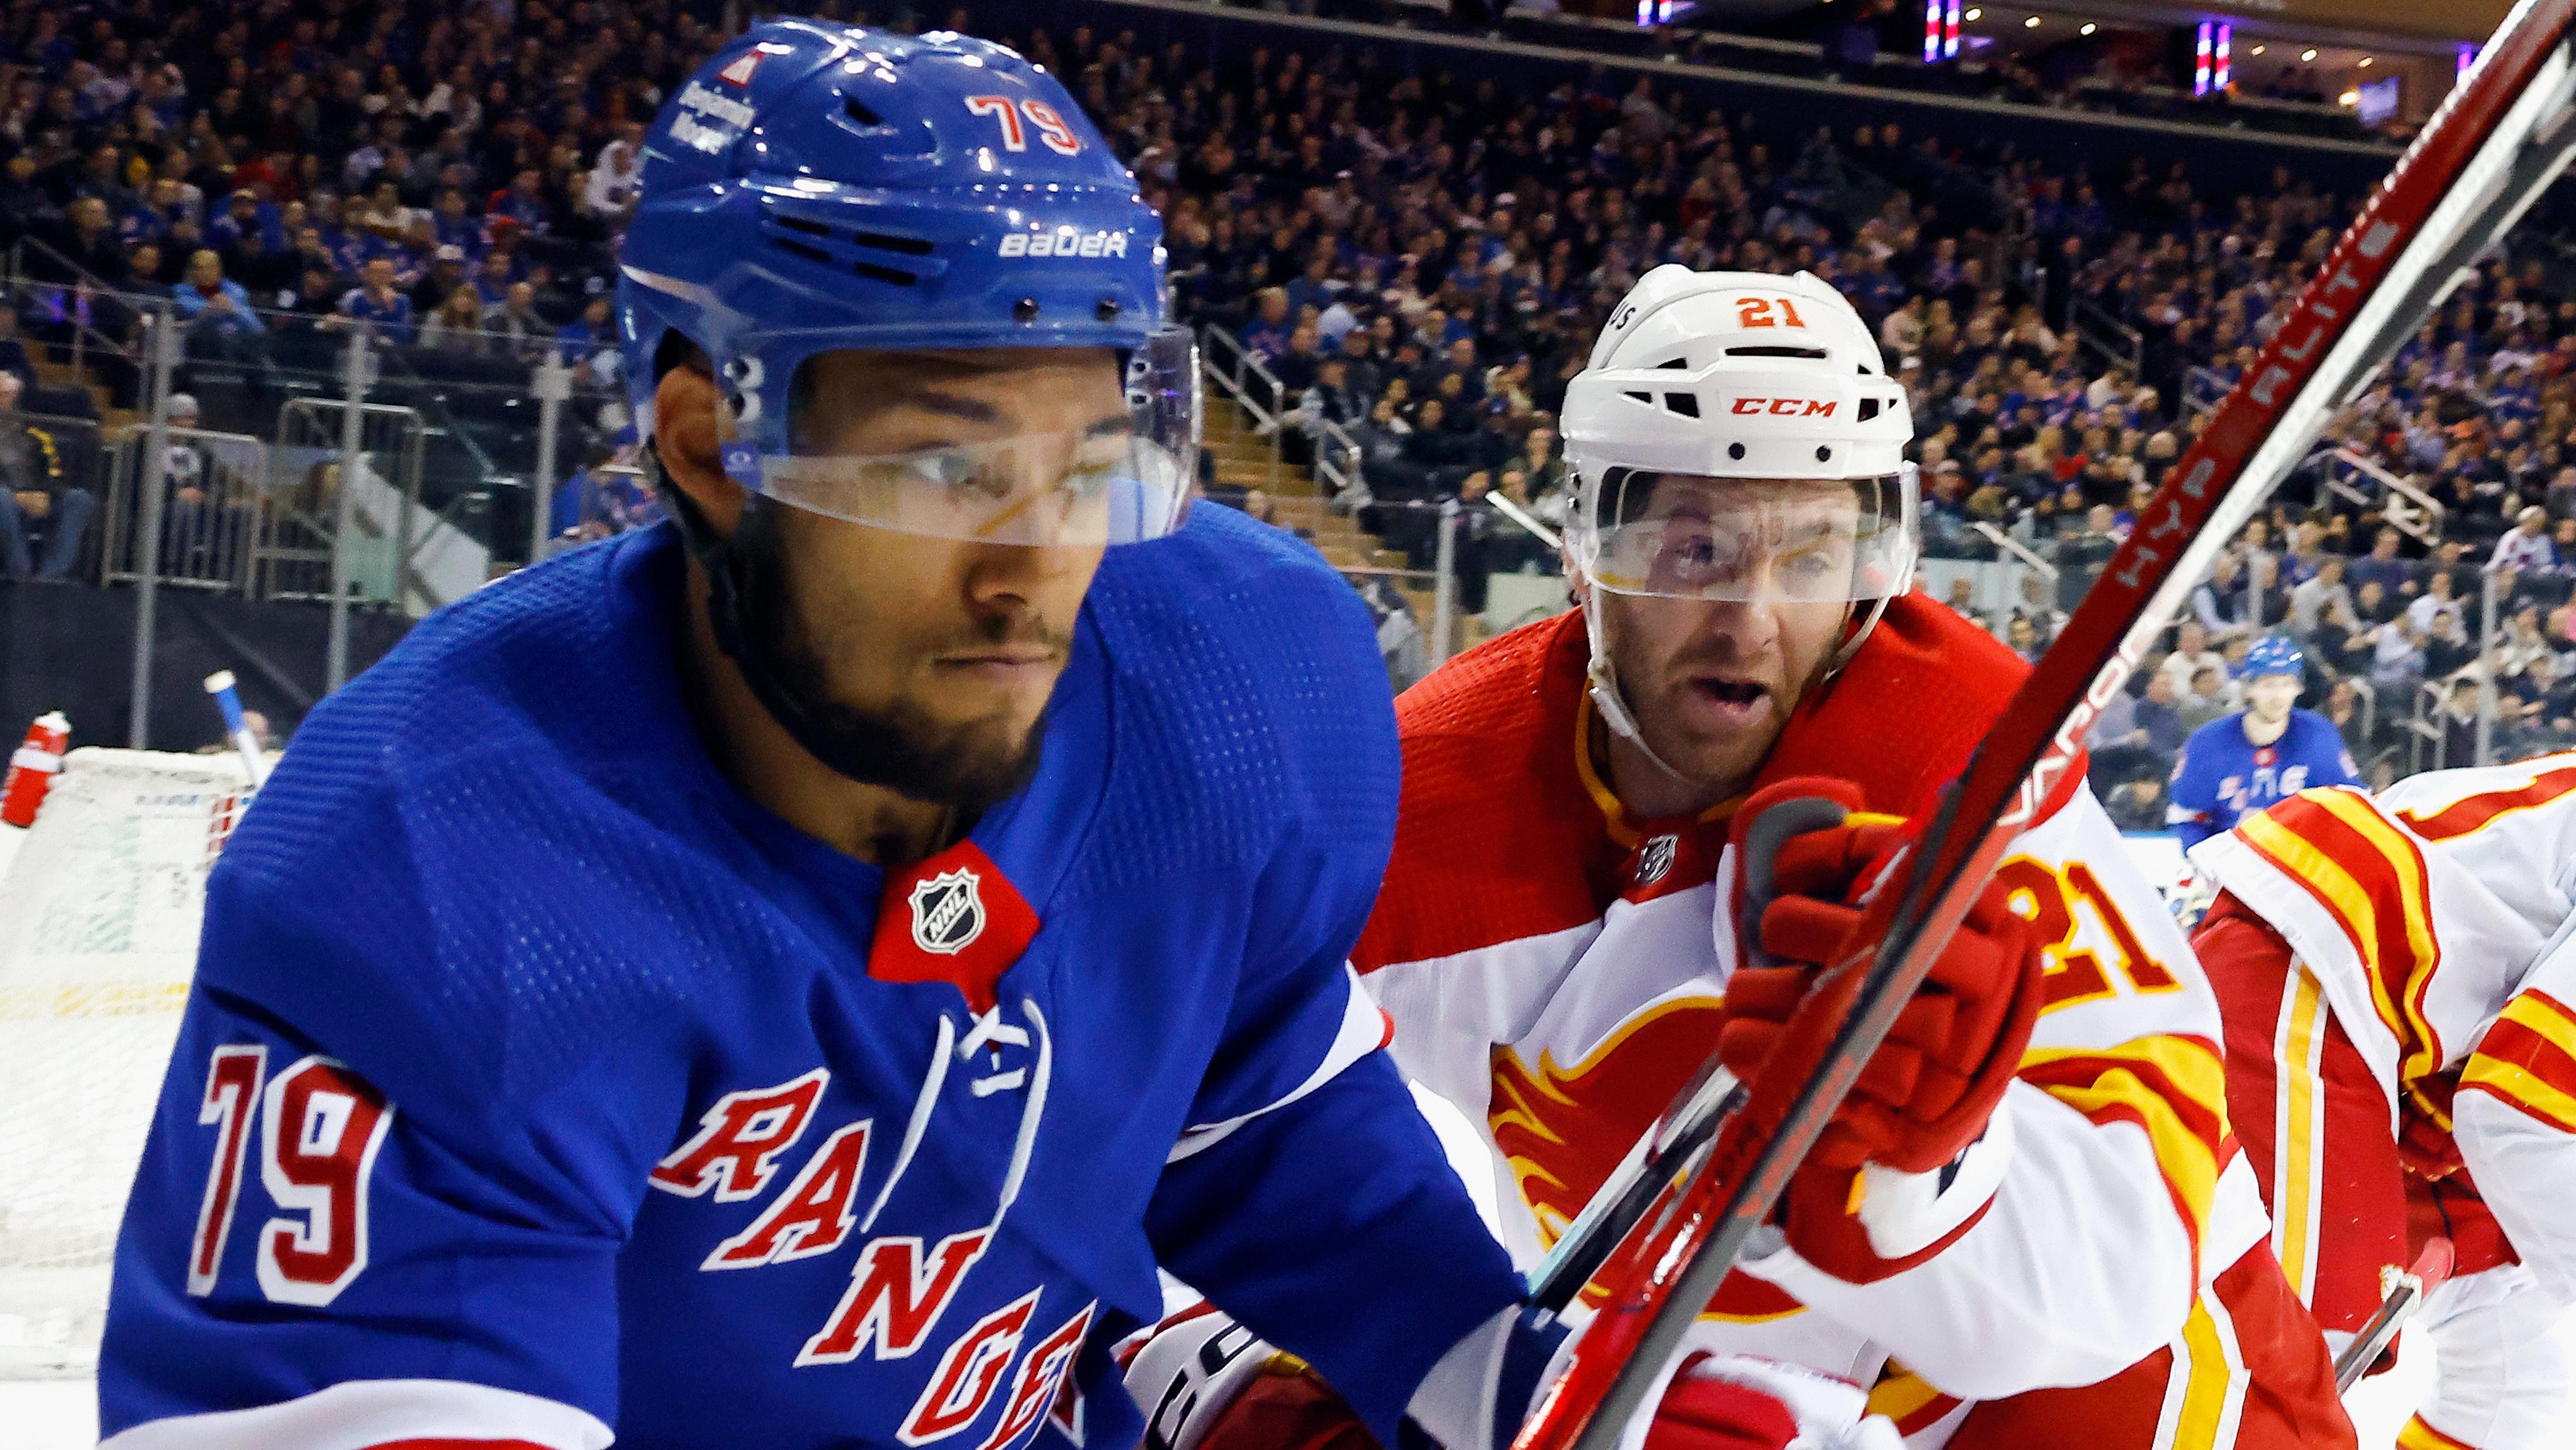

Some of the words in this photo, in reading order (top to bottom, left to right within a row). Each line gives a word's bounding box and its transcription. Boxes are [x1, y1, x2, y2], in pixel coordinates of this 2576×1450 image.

[964, 96, 1080, 156] 79
[1736, 297, 1806, 329] 21
[1731, 398, 1838, 418] CCM
[929, 890, 967, 940] NHL
[1994, 852, 2184, 1018] 21
[187, 1044, 397, 1308] 79
[647, 1066, 1085, 1450] RANGE
